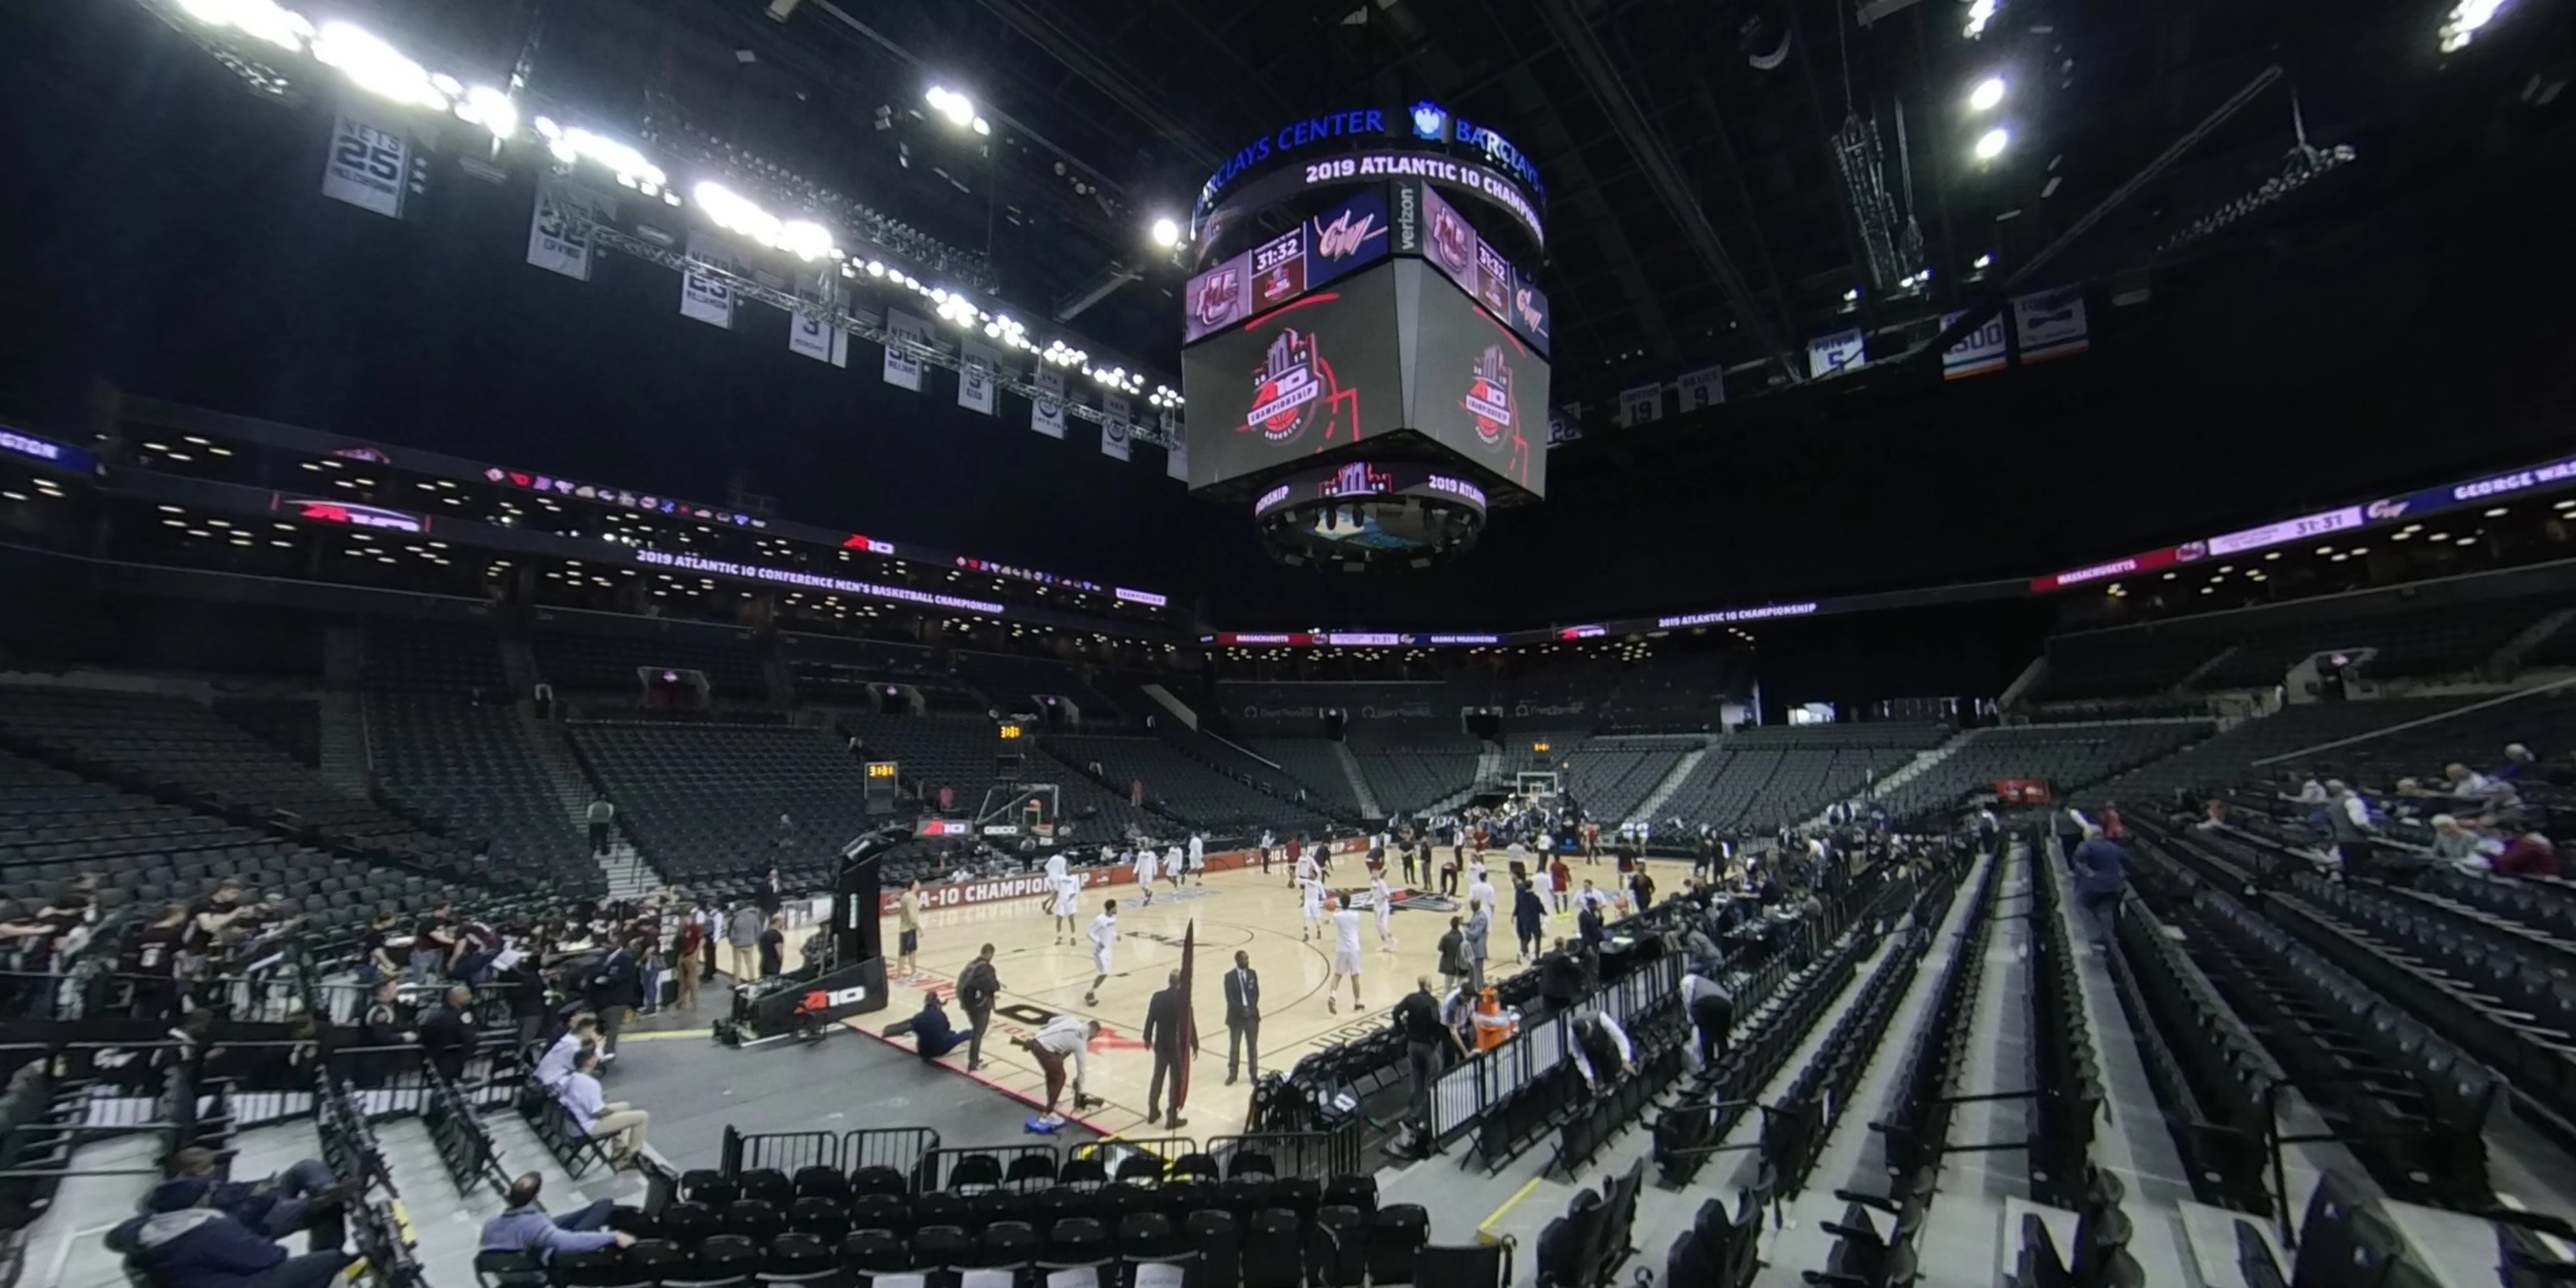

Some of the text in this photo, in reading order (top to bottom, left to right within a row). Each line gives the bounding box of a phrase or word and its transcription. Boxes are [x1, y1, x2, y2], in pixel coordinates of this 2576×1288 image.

[1278, 108, 1385, 151] CENTER
[336, 135, 400, 181] 25
[1455, 118, 1541, 192] BARCLAYS
[1306, 158, 1356, 184] 2019
[1359, 156, 1457, 180] ATLANTIC
[1460, 166, 1480, 187] 10
[1401, 187, 1415, 251] verizon
[1256, 238, 1298, 271] 31:32
[1827, 352, 1845, 371] 5
[1250, 386, 1313, 422] CHAMPIONSHIP
[1630, 400, 1652, 425] 19
[1429, 474, 1457, 494] 2019
[2454, 471, 2534, 500] GEORGE
[2296, 514, 2344, 536] 31:31
[636, 549, 673, 566] 2019
[675, 555, 739, 575] ATLANTIC
[758, 568, 833, 588] CONFERENCE
[835, 578, 870, 594] MEN'S
[871, 585, 934, 604] BASKETBALL
[935, 595, 1005, 613] CHAMPIONSHIP
[2057, 558, 2137, 586] MASSACHUSETTS
[1658, 602, 1817, 628] 2019 ATLANTIC 10 CHAMPIONSHIP
[1235, 634, 1290, 643] MASSACHUSETTS
[1457, 635, 1498, 643] WASHINGTON
[923, 819, 966, 836] A10
[919, 887, 960, 908] A-10
[793, 985, 866, 1015] A10
